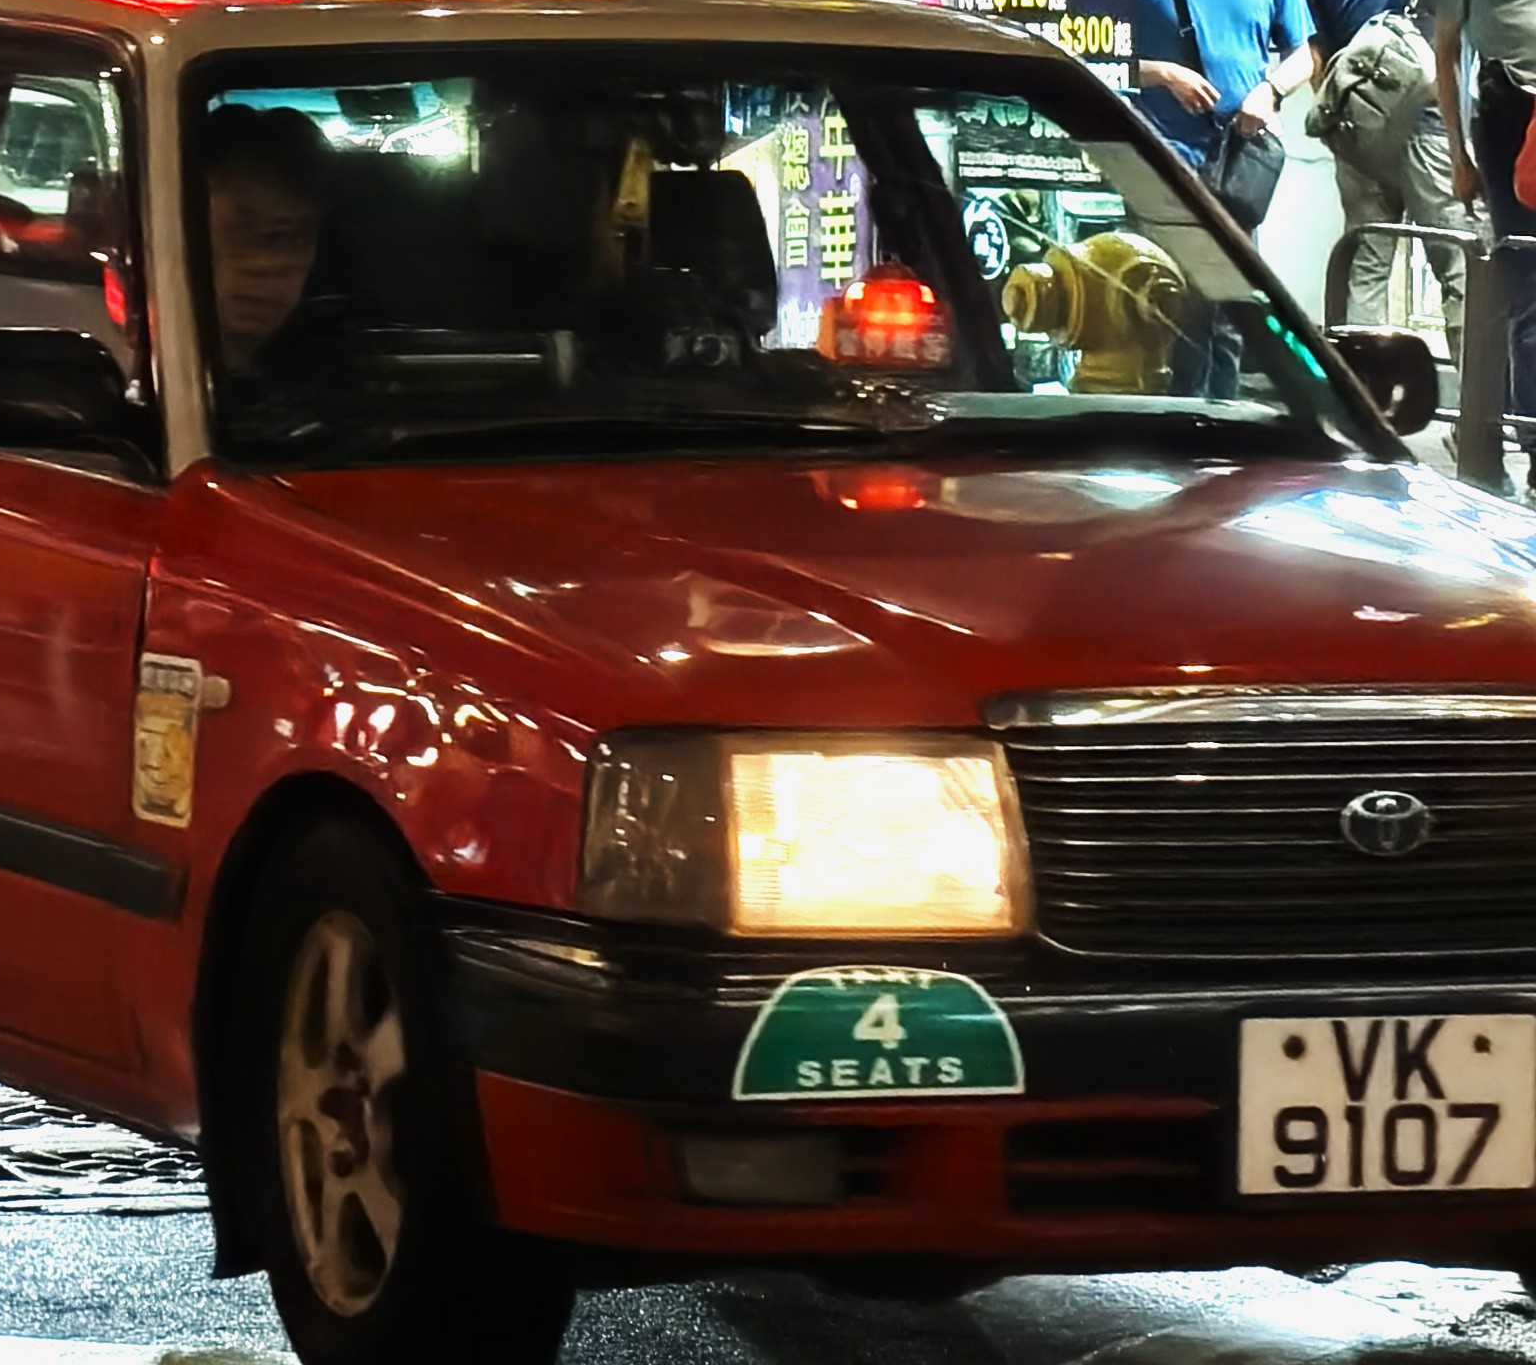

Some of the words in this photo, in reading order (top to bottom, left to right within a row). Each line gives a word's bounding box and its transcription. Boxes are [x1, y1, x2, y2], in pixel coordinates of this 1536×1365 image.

[852, 992, 908, 1050] 4
[796, 1055, 965, 1089] SEATS
[1330, 1018, 1447, 1102] VK
[1273, 1103, 1502, 1190] 9107
